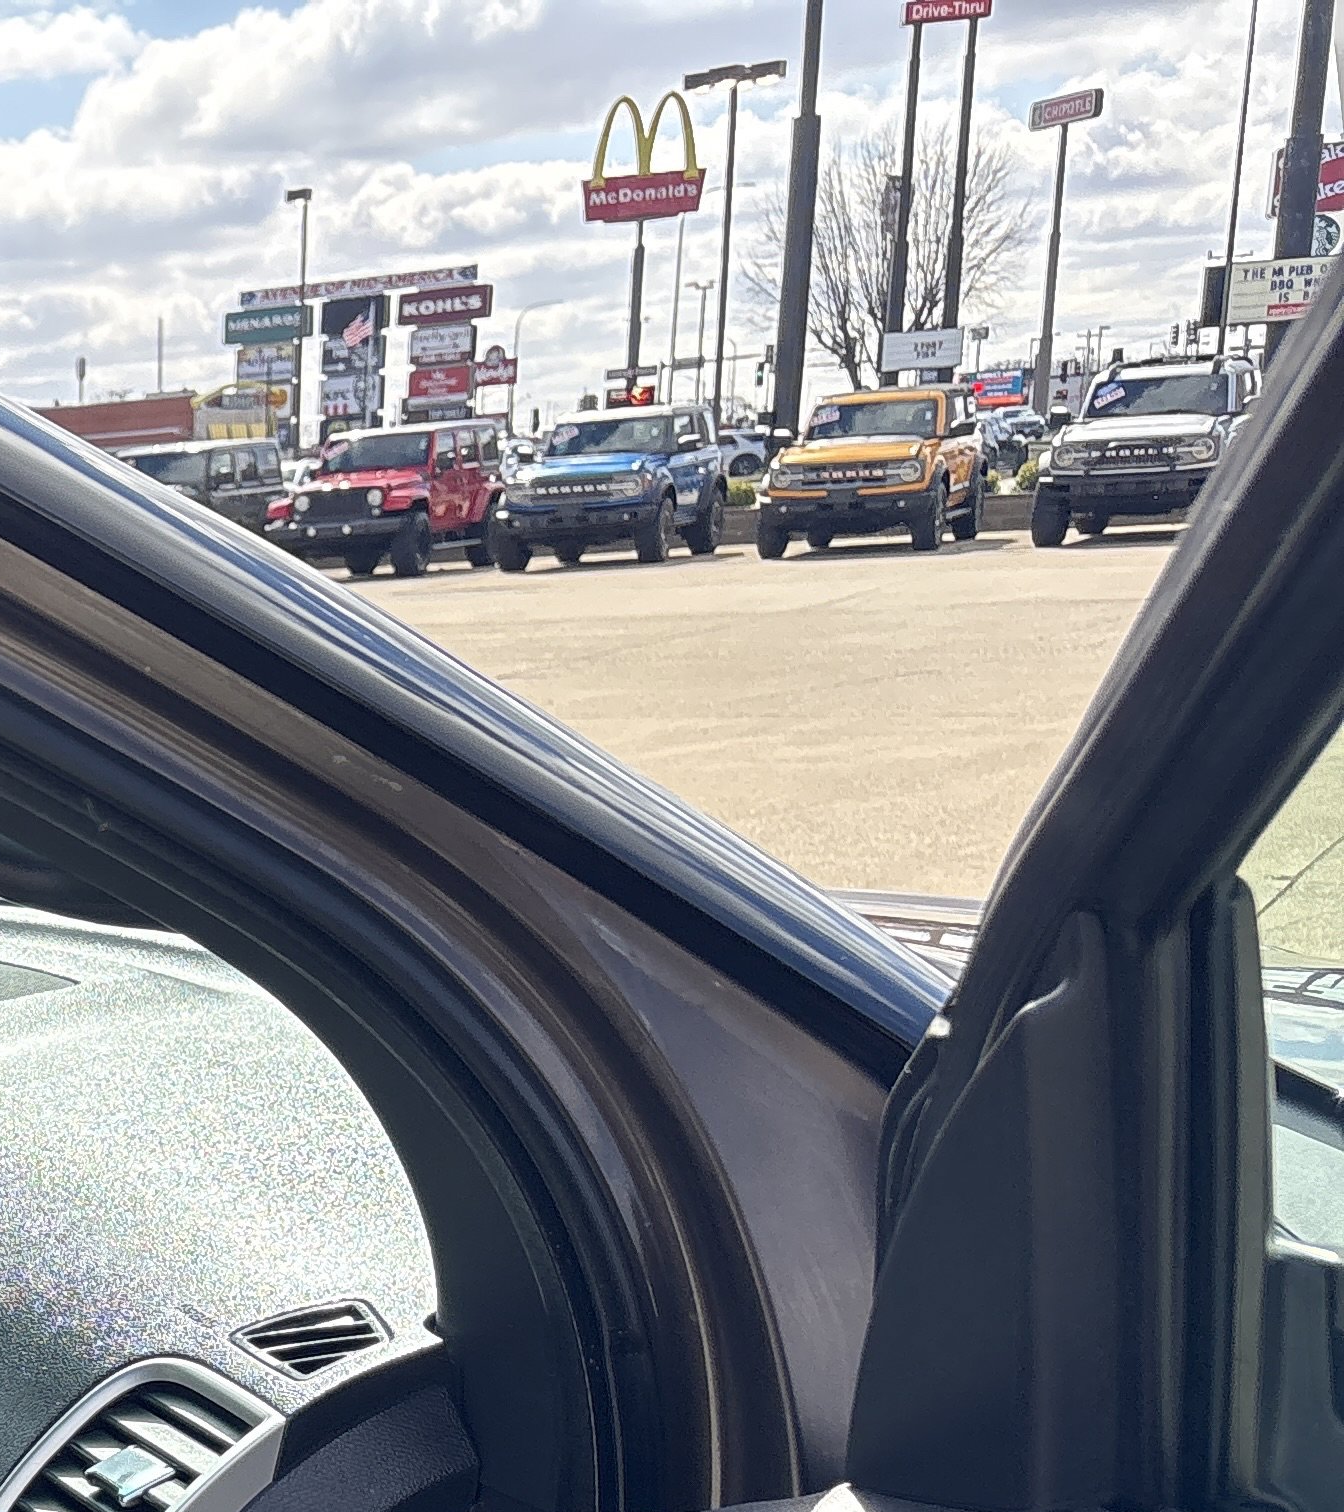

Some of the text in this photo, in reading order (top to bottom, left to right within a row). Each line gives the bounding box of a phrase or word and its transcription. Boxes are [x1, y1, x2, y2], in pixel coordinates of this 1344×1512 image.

[912, 1, 985, 19] Drive-Thru
[1044, 97, 1092, 120] CHIPOTLE
[589, 183, 698, 206] McDonald's
[402, 294, 482, 317] KOHL'S
